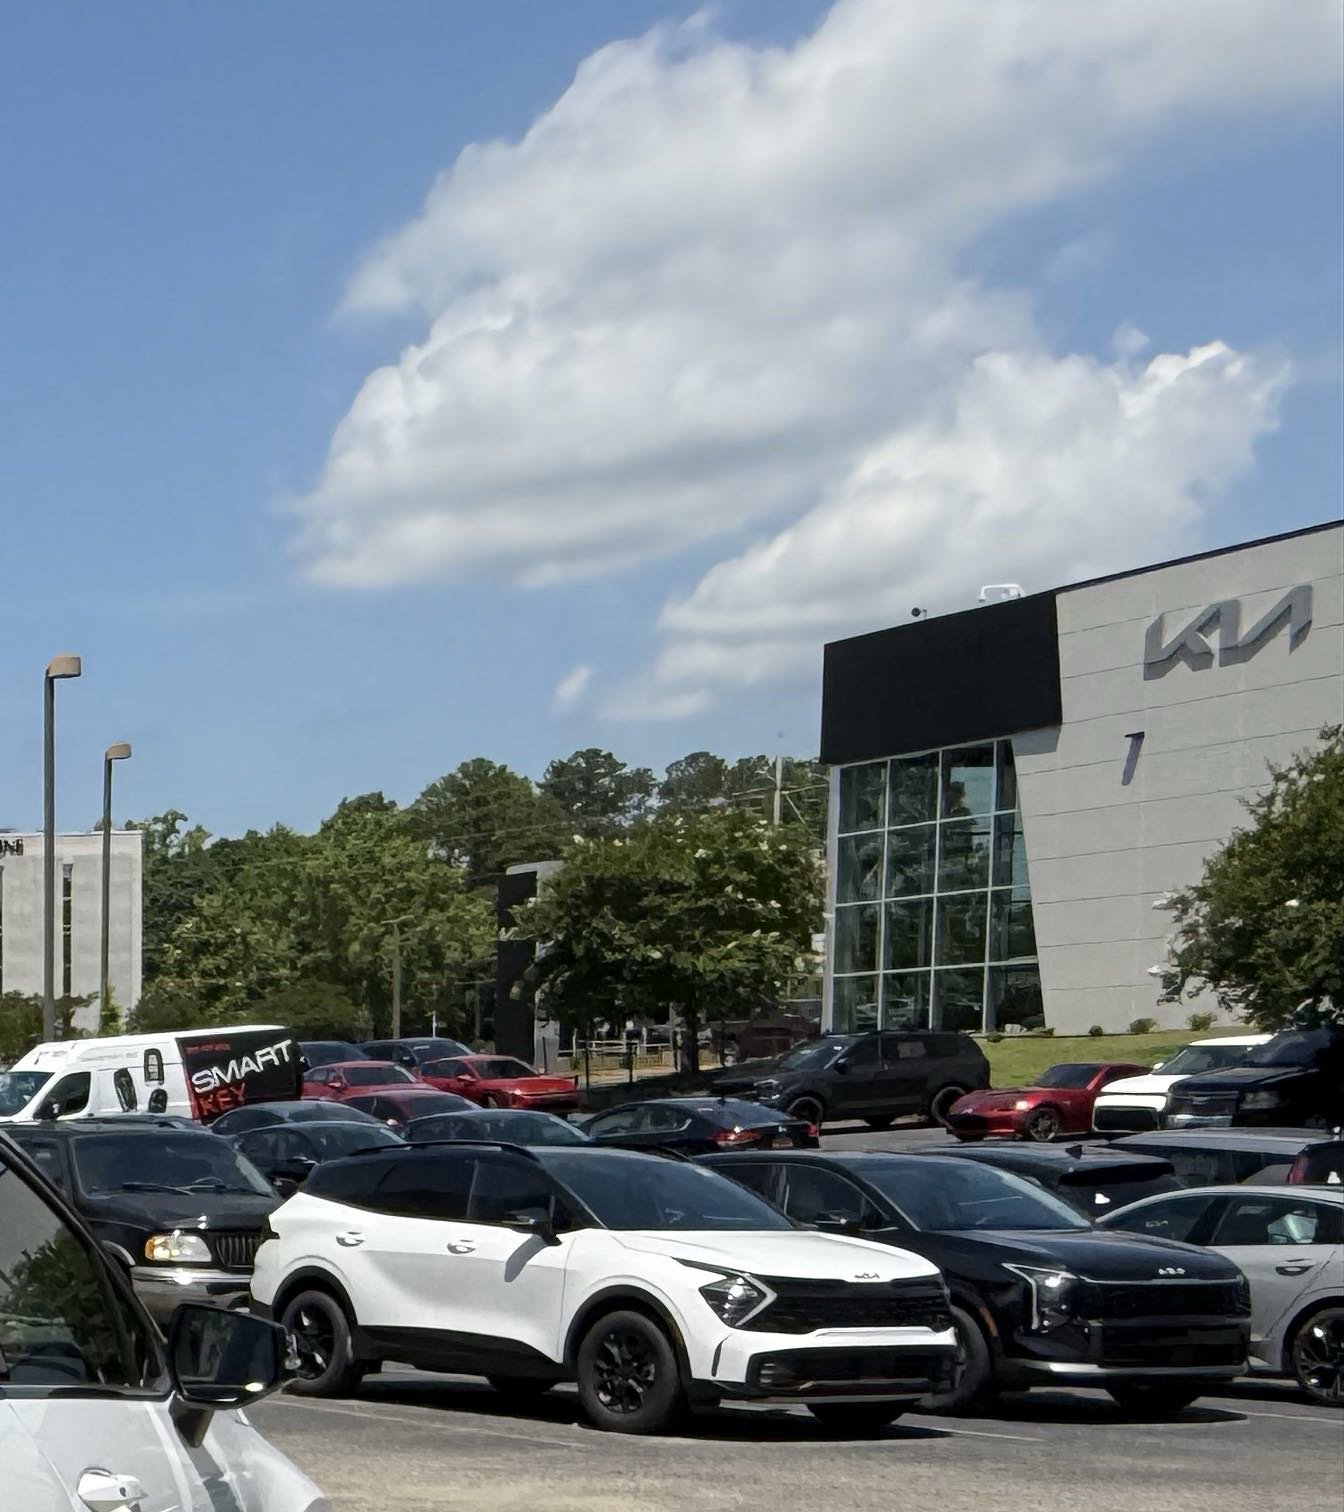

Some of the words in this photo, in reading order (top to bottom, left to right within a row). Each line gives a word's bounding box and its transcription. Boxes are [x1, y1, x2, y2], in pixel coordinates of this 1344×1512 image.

[1143, 585, 1312, 681] KIA
[191, 1039, 293, 1094] SMART
[198, 1082, 246, 1116] KEY
